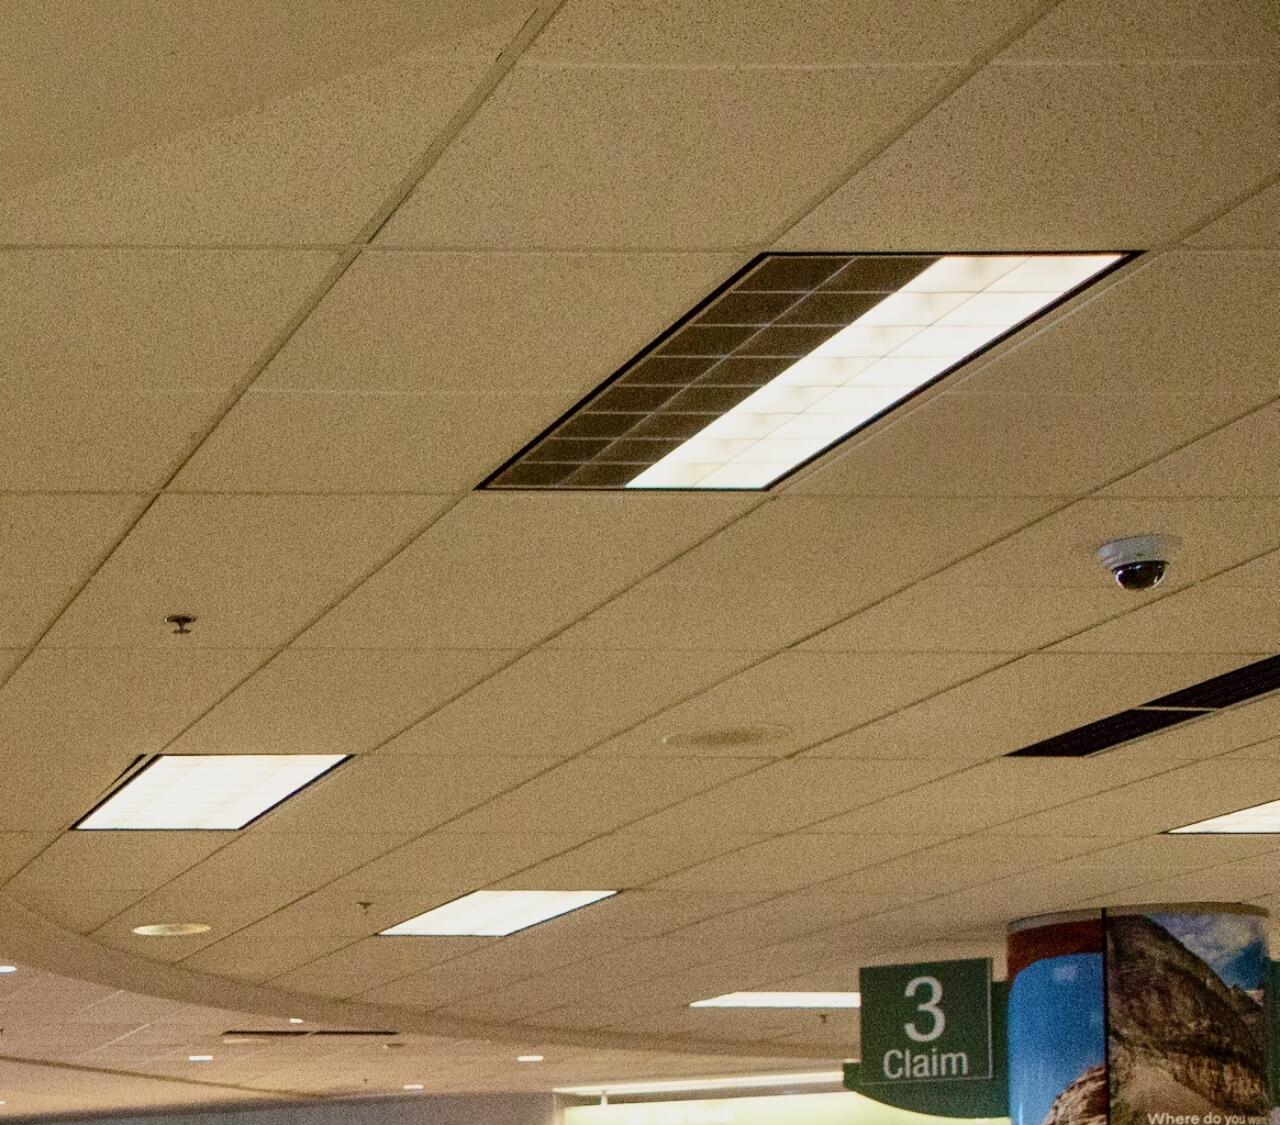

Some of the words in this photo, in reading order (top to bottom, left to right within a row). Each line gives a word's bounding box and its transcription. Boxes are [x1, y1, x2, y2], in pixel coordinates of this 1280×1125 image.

[903, 975, 946, 1042] 3
[883, 1048, 969, 1080] Claim
[1147, 1112, 1200, 1125] Where
[1203, 1111, 1222, 1125] do
